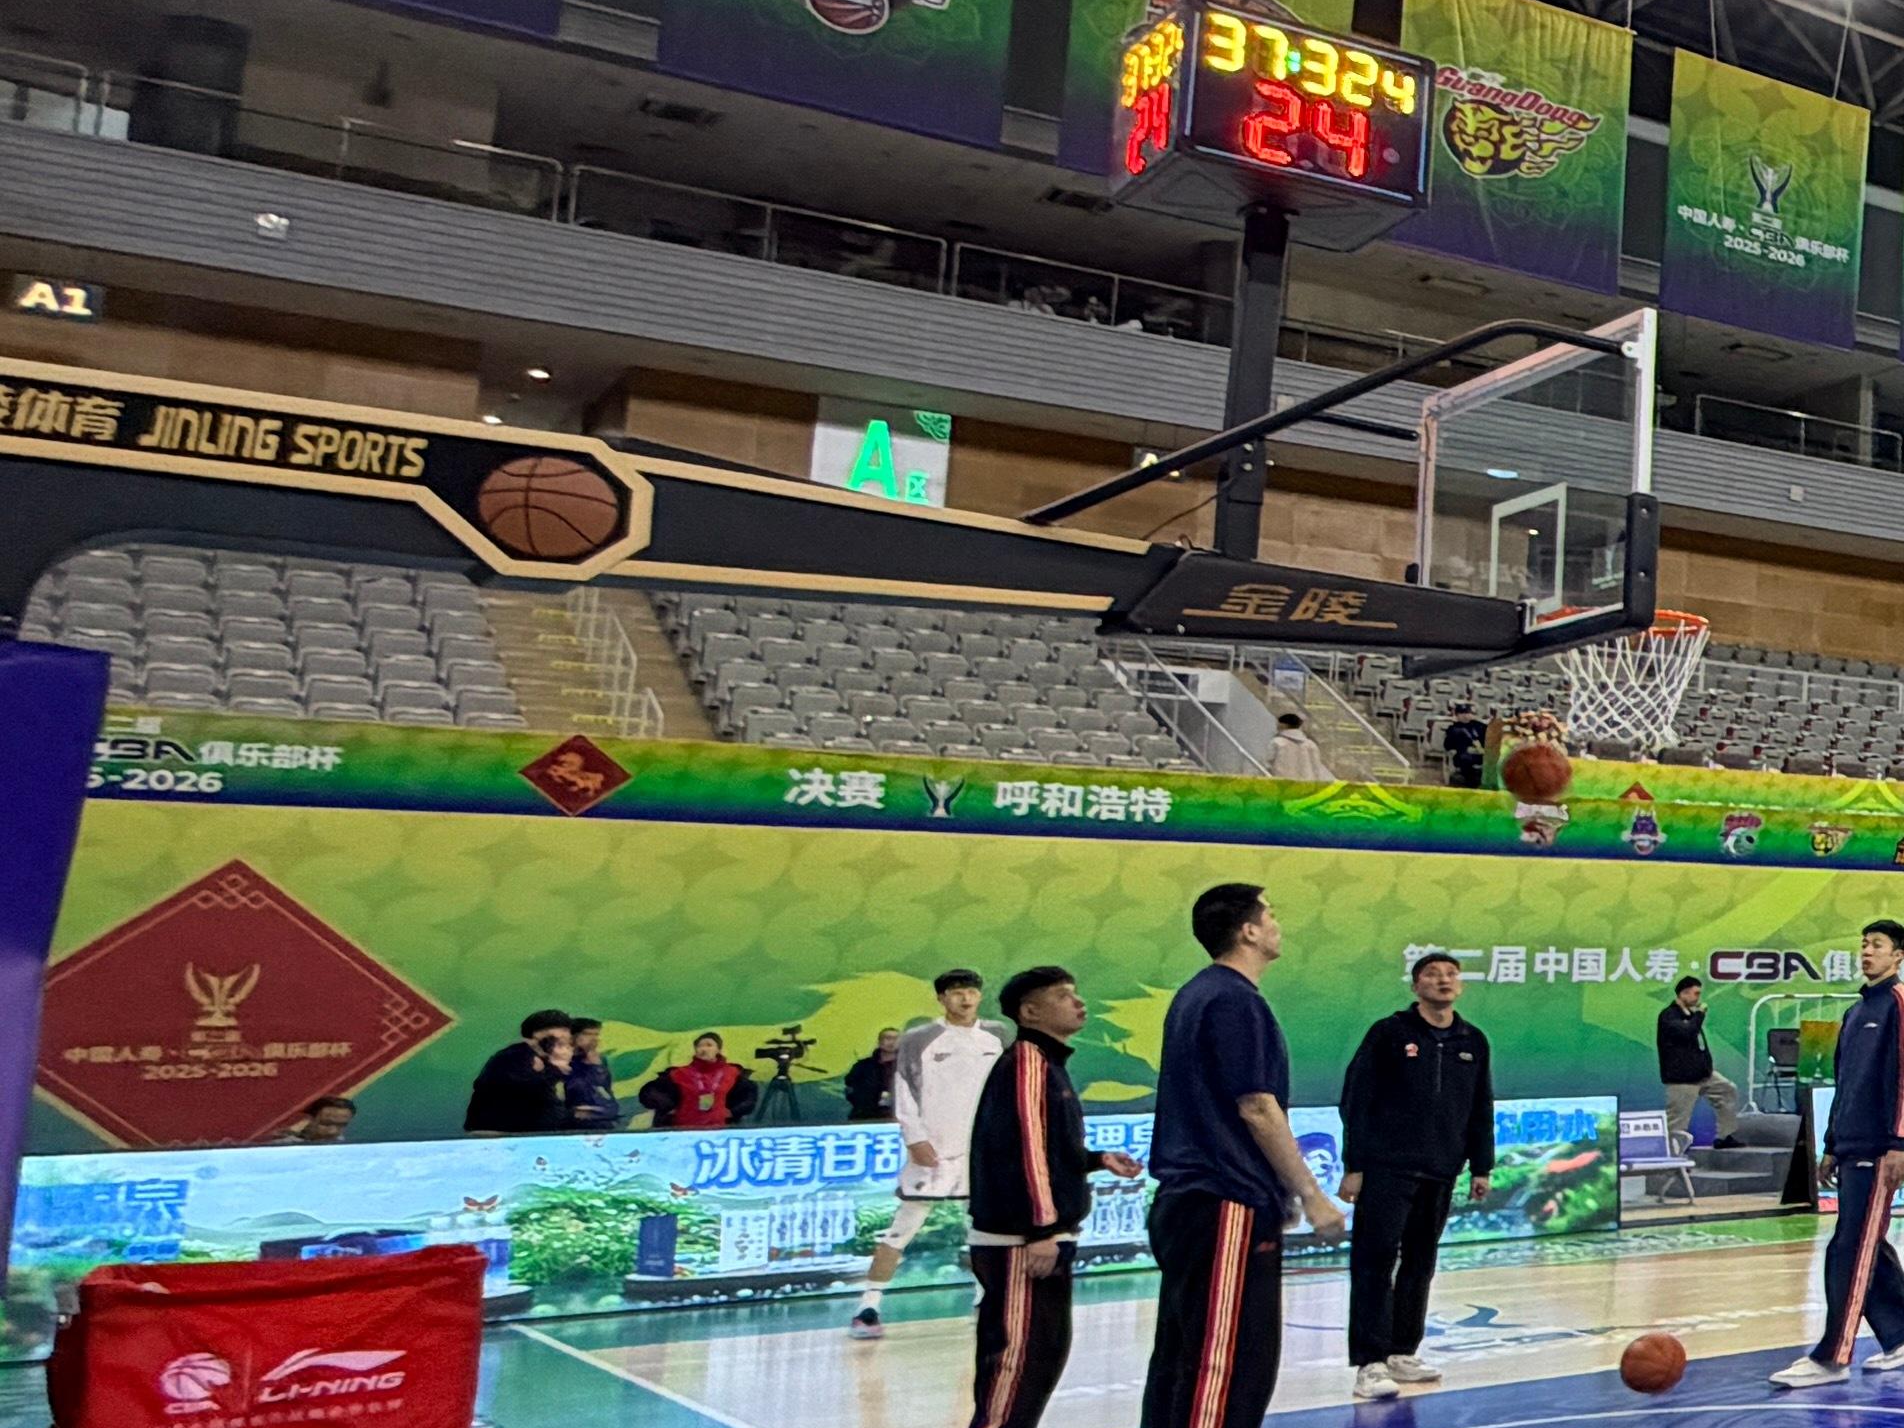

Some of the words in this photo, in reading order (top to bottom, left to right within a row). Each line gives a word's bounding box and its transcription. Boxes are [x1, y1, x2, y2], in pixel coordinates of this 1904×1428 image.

[1435, 66, 1591, 128] GuangDong
[1241, 78, 1371, 177] 24
[18, 281, 93, 316] A1
[289, 422, 428, 479] SPORTS
[1181, 582, 1398, 630] 金陵
[784, 766, 887, 810] 决赛
[991, 779, 1174, 824] 呼和浩特
[141, 1061, 279, 1081] 2025-2026
[258, 1372, 407, 1403] LI-NING
